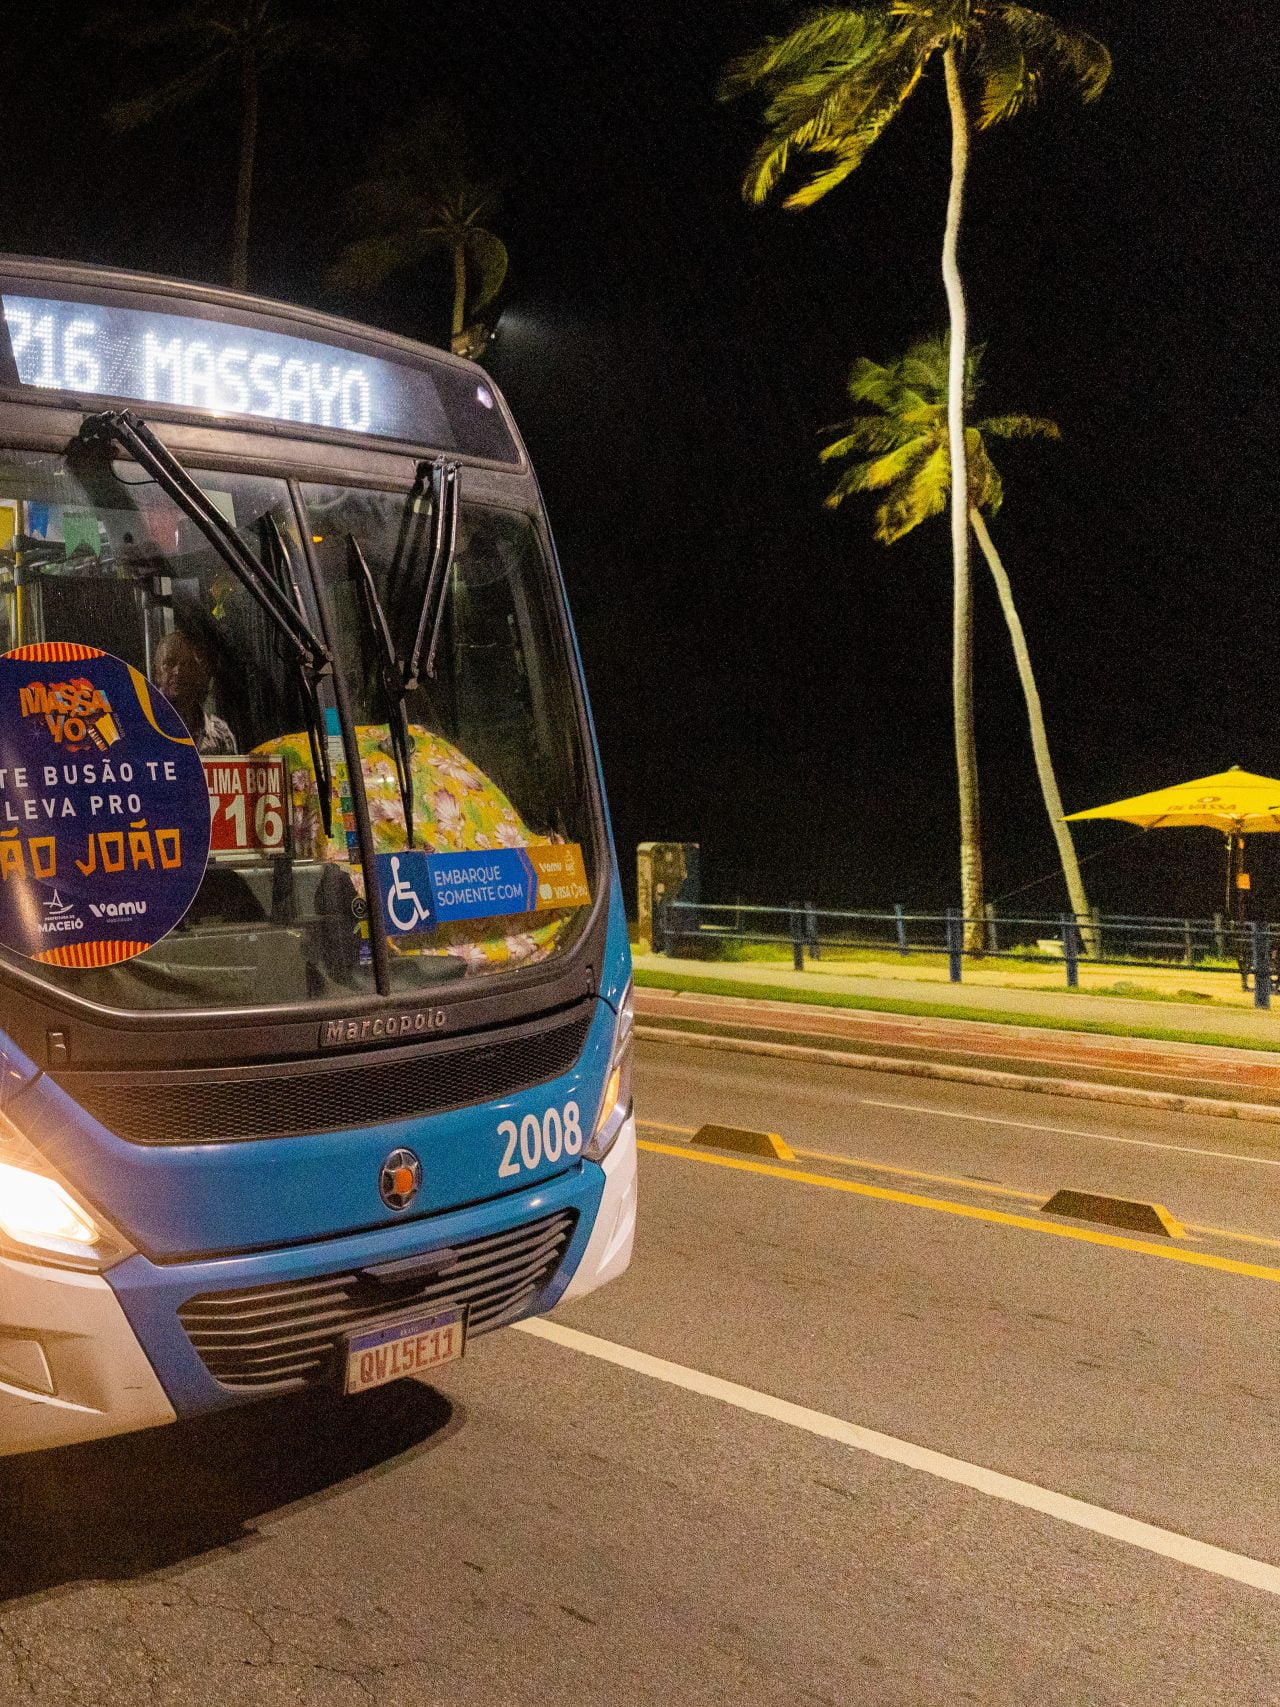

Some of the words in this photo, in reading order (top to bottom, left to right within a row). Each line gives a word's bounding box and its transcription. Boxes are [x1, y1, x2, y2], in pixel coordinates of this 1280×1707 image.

[4, 308, 100, 391] 716
[142, 330, 370, 433] MASSAYO
[43, 759, 134, 787] BUSÃO
[146, 761, 177, 782] TE
[246, 767, 281, 794] BOM
[4, 796, 77, 821] LEVA
[91, 794, 142, 815] PRO
[75, 818, 182, 878] JOÃO
[434, 865, 502, 887] EMBARQUE
[437, 886, 496, 907] SOMENTE
[497, 883, 524, 900] COM
[38, 917, 84, 934] MACEIÓ
[326, 1008, 446, 1044] Marcopolo
[497, 1101, 583, 1178] 2008
